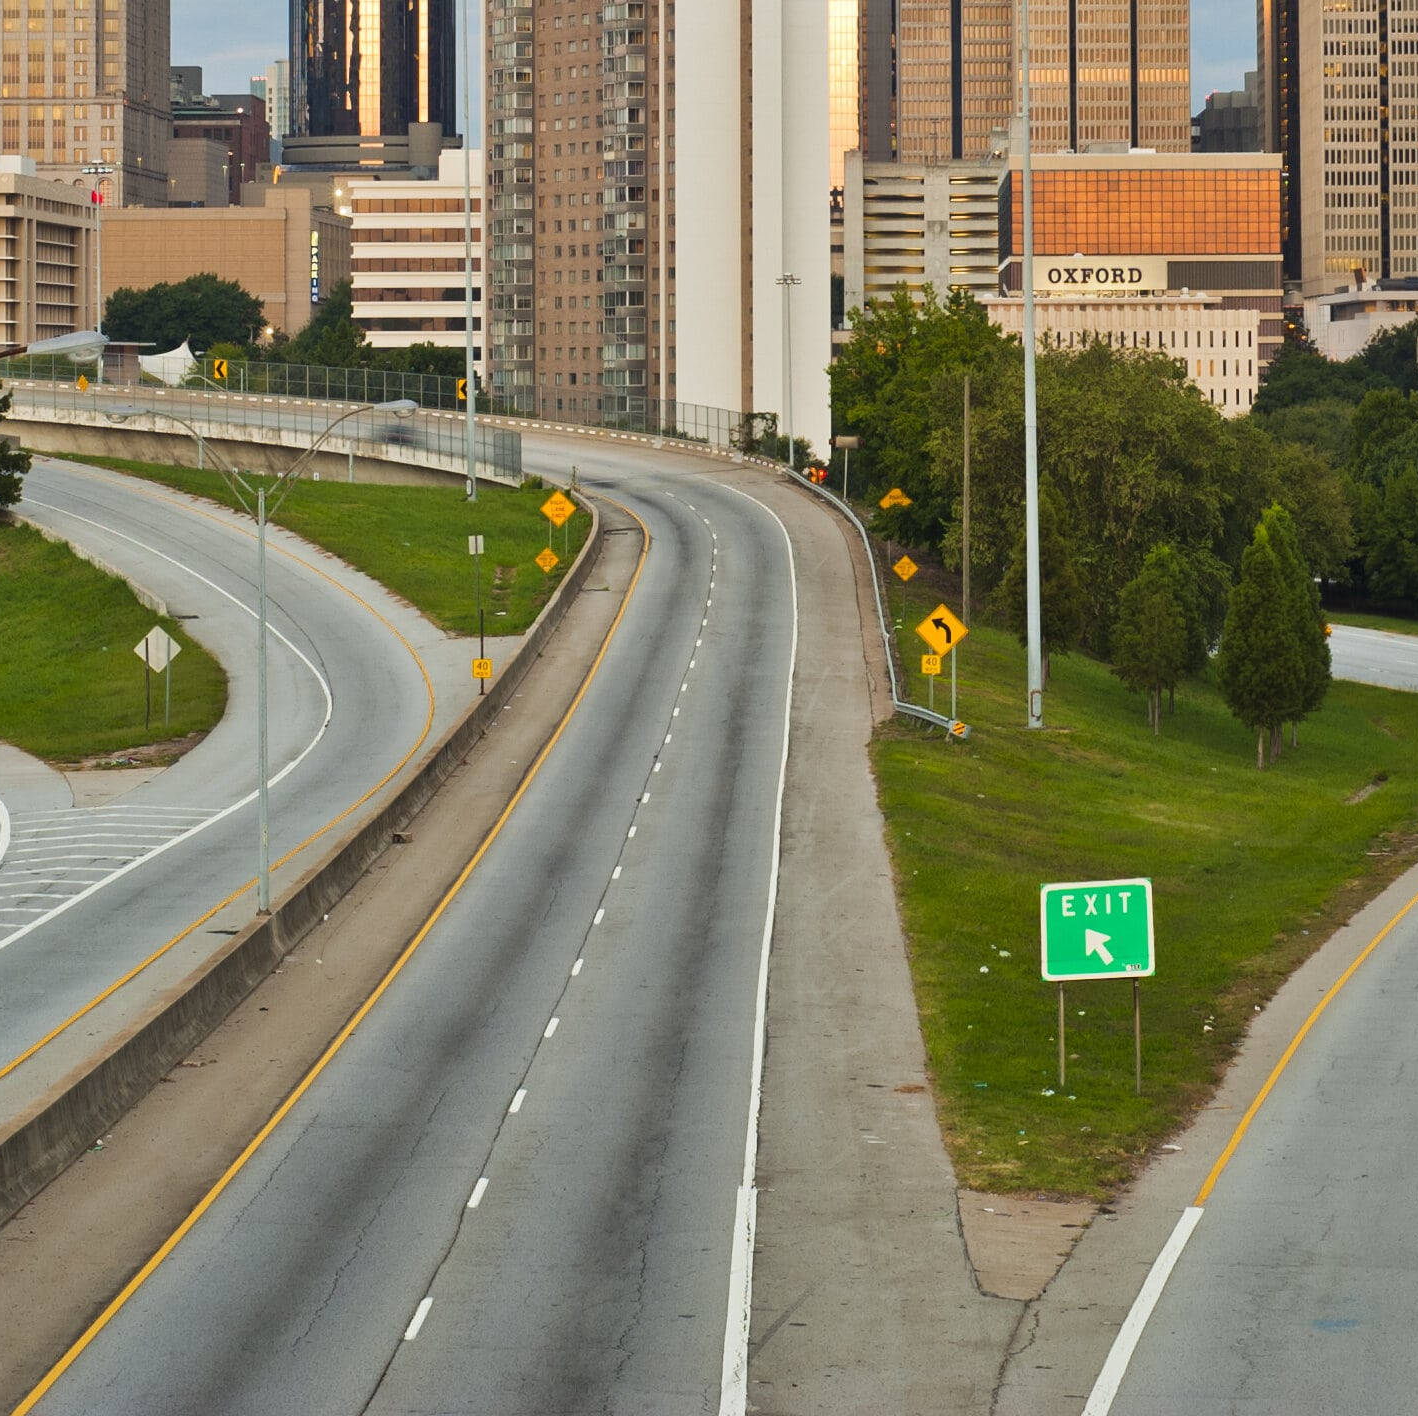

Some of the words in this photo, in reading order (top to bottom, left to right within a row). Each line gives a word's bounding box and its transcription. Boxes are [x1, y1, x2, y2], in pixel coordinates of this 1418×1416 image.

[1048, 268, 1142, 284] OXFORD
[477, 661, 488, 671] 40
[926, 657, 938, 666] 40
[1061, 892, 1132, 917] EXIT
